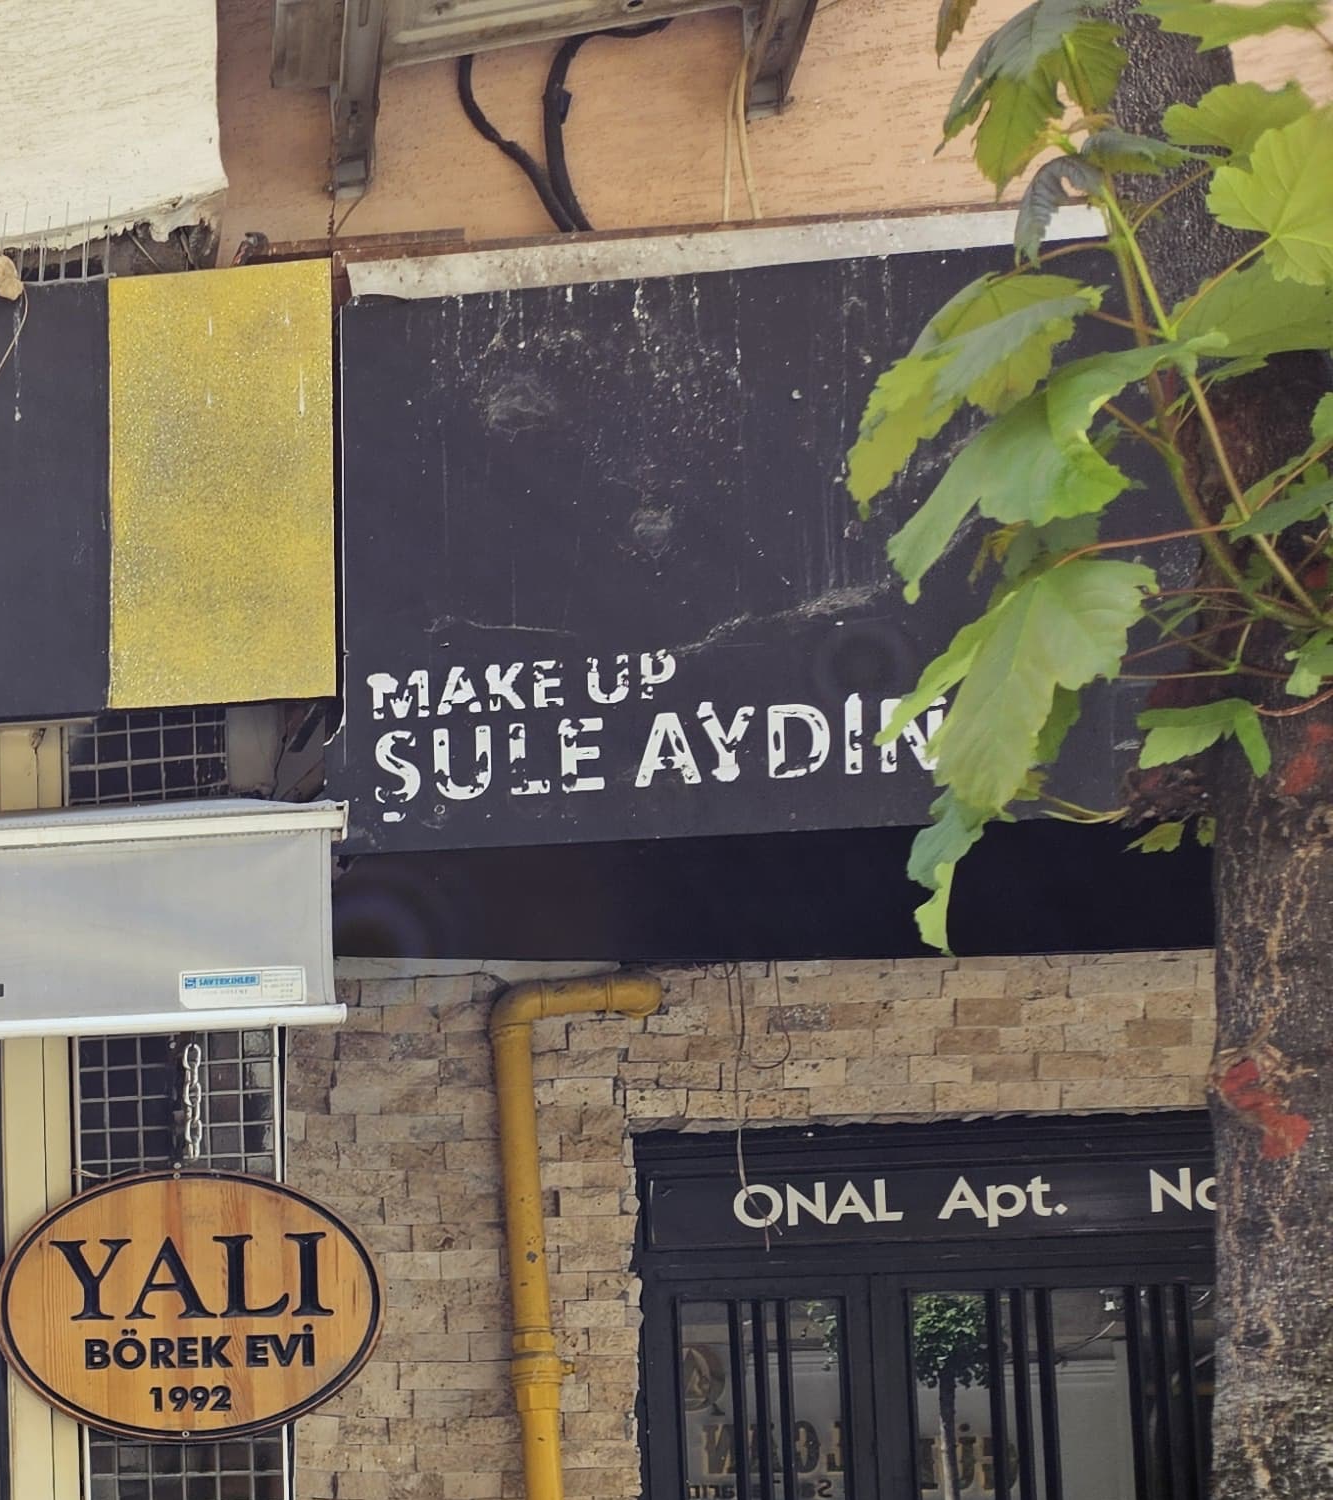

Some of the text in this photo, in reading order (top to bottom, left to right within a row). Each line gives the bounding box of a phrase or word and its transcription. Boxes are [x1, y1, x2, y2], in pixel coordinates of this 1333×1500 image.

[366, 650, 676, 720] MAKE UP
[733, 1179, 903, 1228] ONAL
[938, 1176, 1068, 1229] Apt.
[49, 1232, 334, 1321] YALI
[85, 1324, 315, 1370] BÖREK EVİ
[149, 1386, 232, 1412] 1992
